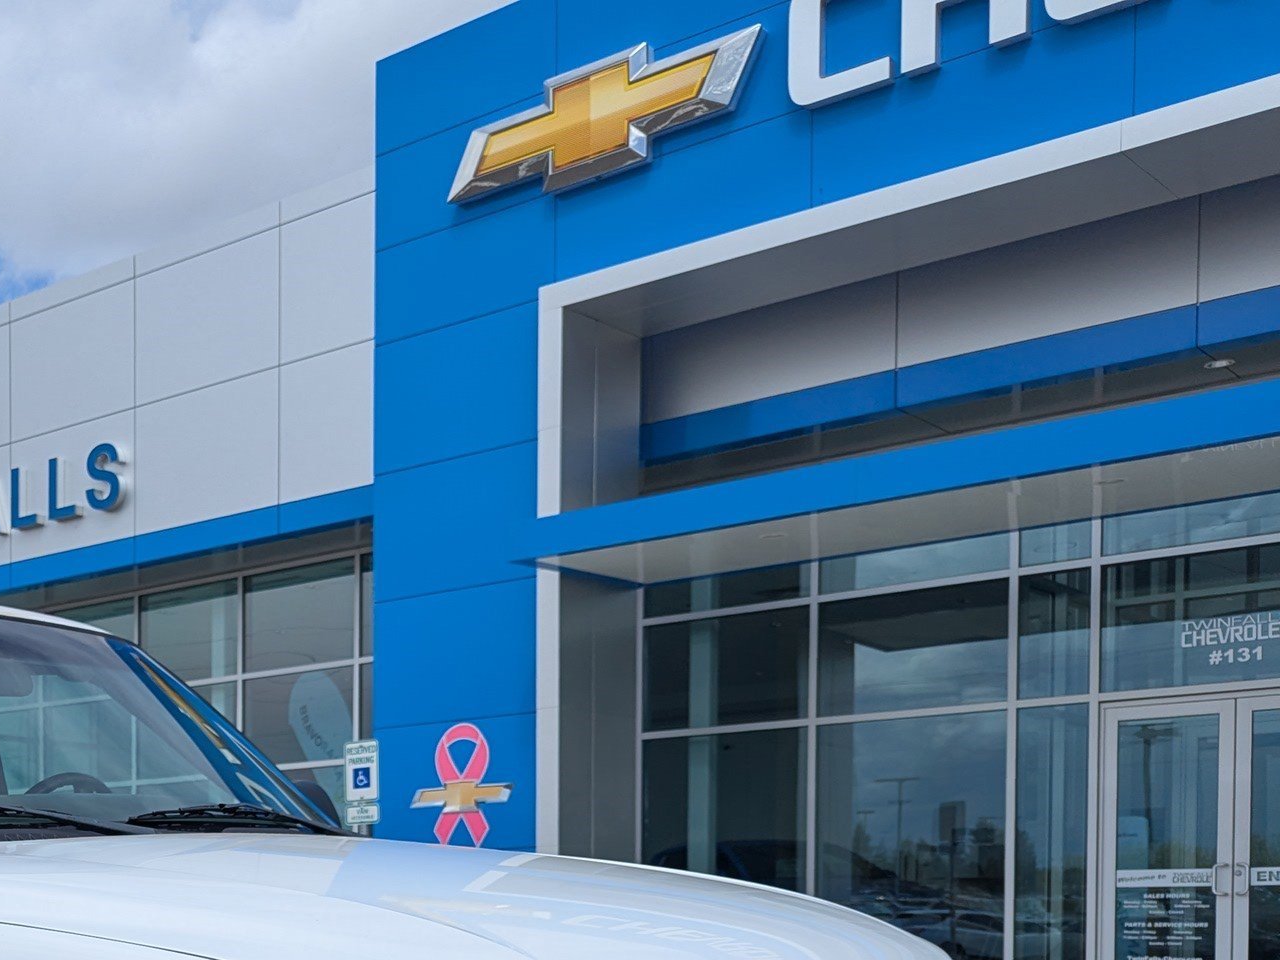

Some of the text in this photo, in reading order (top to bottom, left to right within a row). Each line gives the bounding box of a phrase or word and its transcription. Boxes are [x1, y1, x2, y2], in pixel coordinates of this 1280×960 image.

[1209, 645, 1263, 666] #131
[347, 745, 376, 755] RESERVED
[349, 756, 375, 764] PARKING
[1256, 870, 1280, 882] EN
